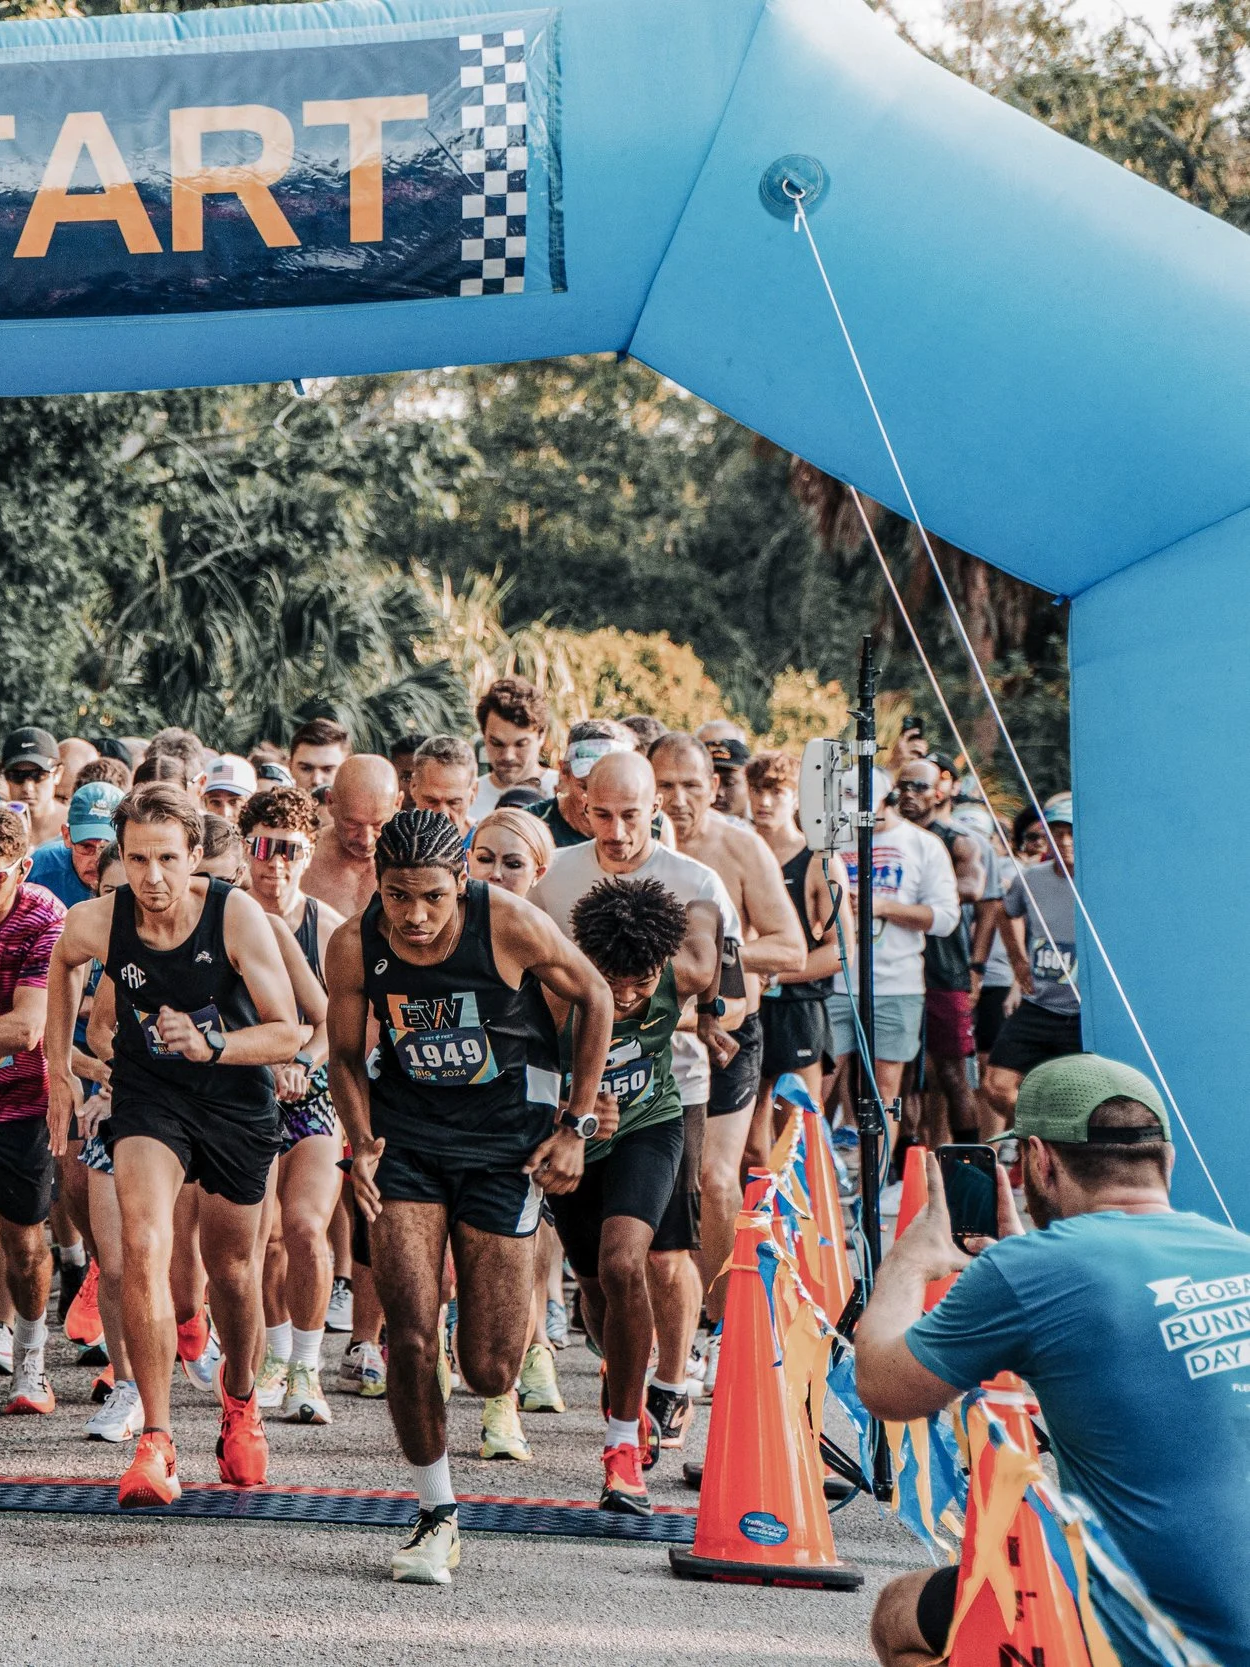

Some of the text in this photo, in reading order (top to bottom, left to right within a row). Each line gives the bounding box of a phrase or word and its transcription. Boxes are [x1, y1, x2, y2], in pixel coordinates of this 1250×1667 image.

[121, 962, 147, 990] FRC
[405, 1038, 483, 1068] 1949
[441, 1069, 467, 1078] 2024
[598, 1069, 646, 1097] 950
[1166, 1306, 1250, 1346] RUNN
[1190, 1344, 1241, 1374] DAY
